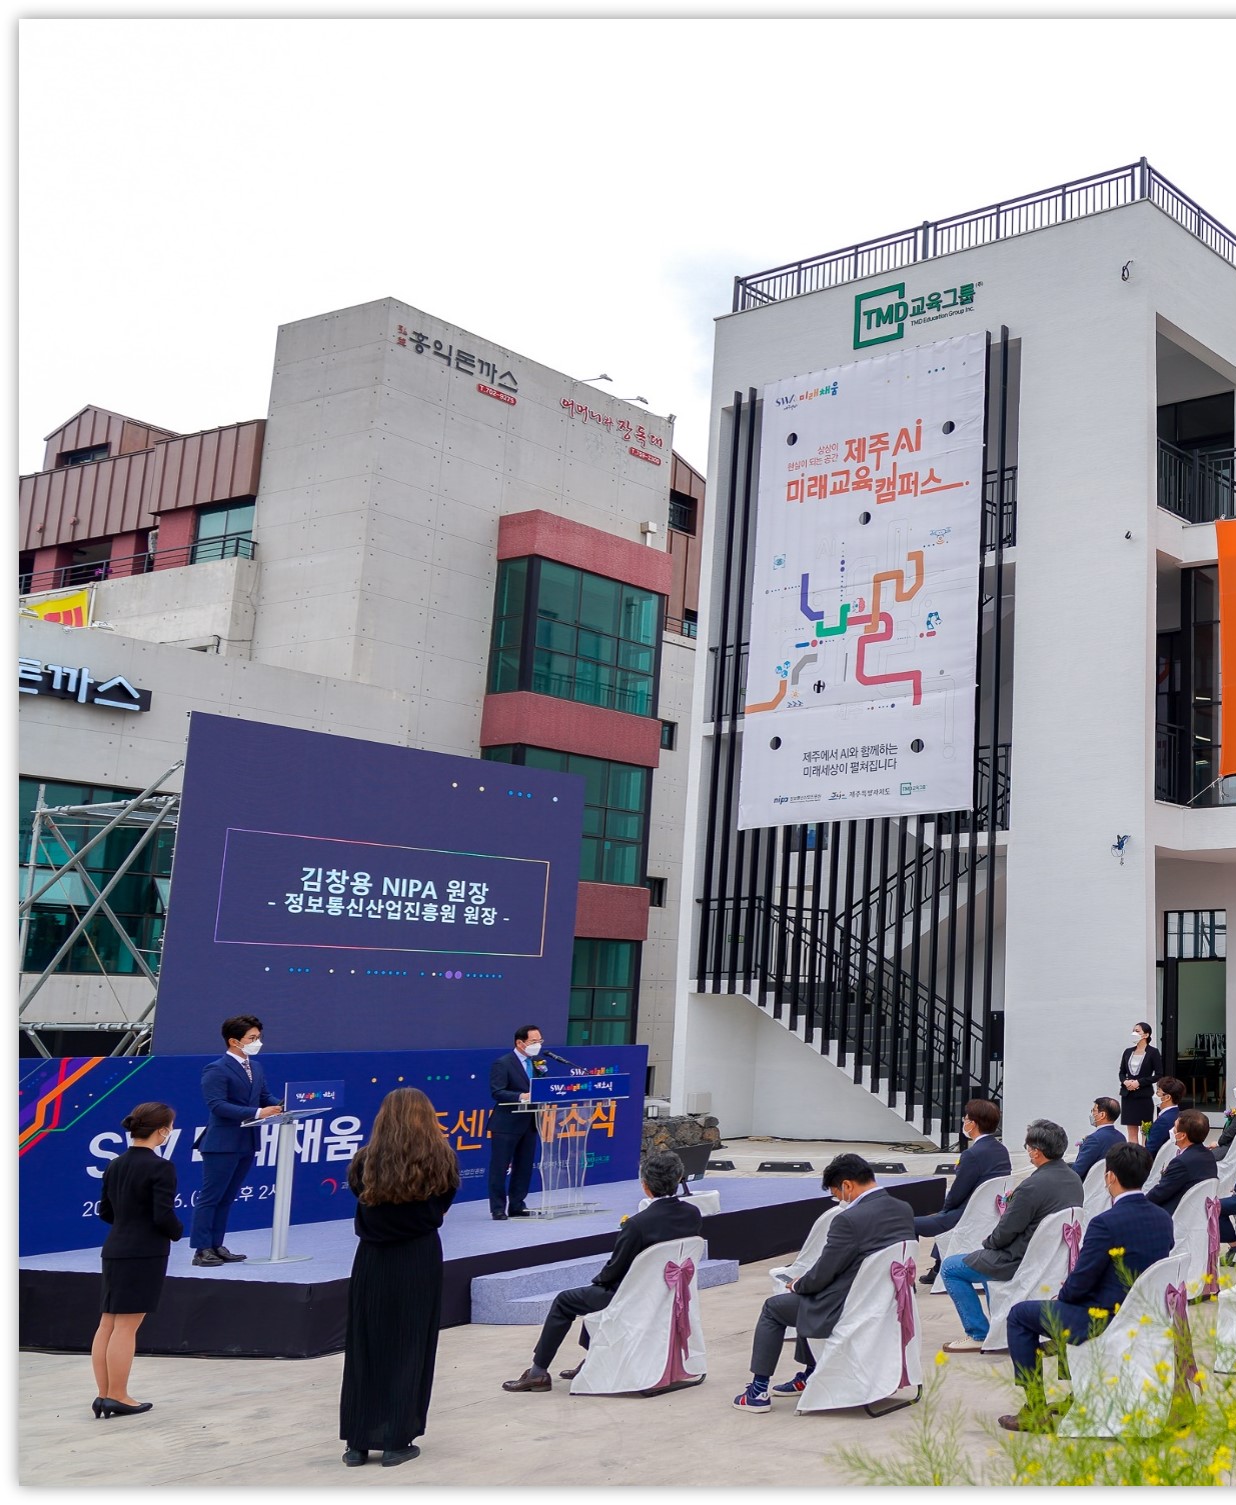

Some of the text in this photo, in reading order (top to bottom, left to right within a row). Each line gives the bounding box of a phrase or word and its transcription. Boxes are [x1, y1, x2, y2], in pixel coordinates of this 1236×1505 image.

[862, 301, 909, 330] TMD
[909, 282, 976, 318] 교육그룹
[923, 312, 949, 324] Education
[949, 308, 965, 317] Group
[409, 330, 519, 393] 홍익돈까스
[799, 381, 839, 401] 미래채움
[817, 442, 839, 455] 상상이
[843, 432, 890, 472] 제주
[786, 465, 874, 504] 미래교육
[802, 742, 899, 763] 제주에서 AI와 함께하는
[802, 757, 898, 778] 미래세상이 펼쳐집니다
[300, 866, 490, 905] 김창용 NIPA 원장
[284, 892, 457, 924] 정보통신산업진흥원
[463, 906, 498, 926] 원장
